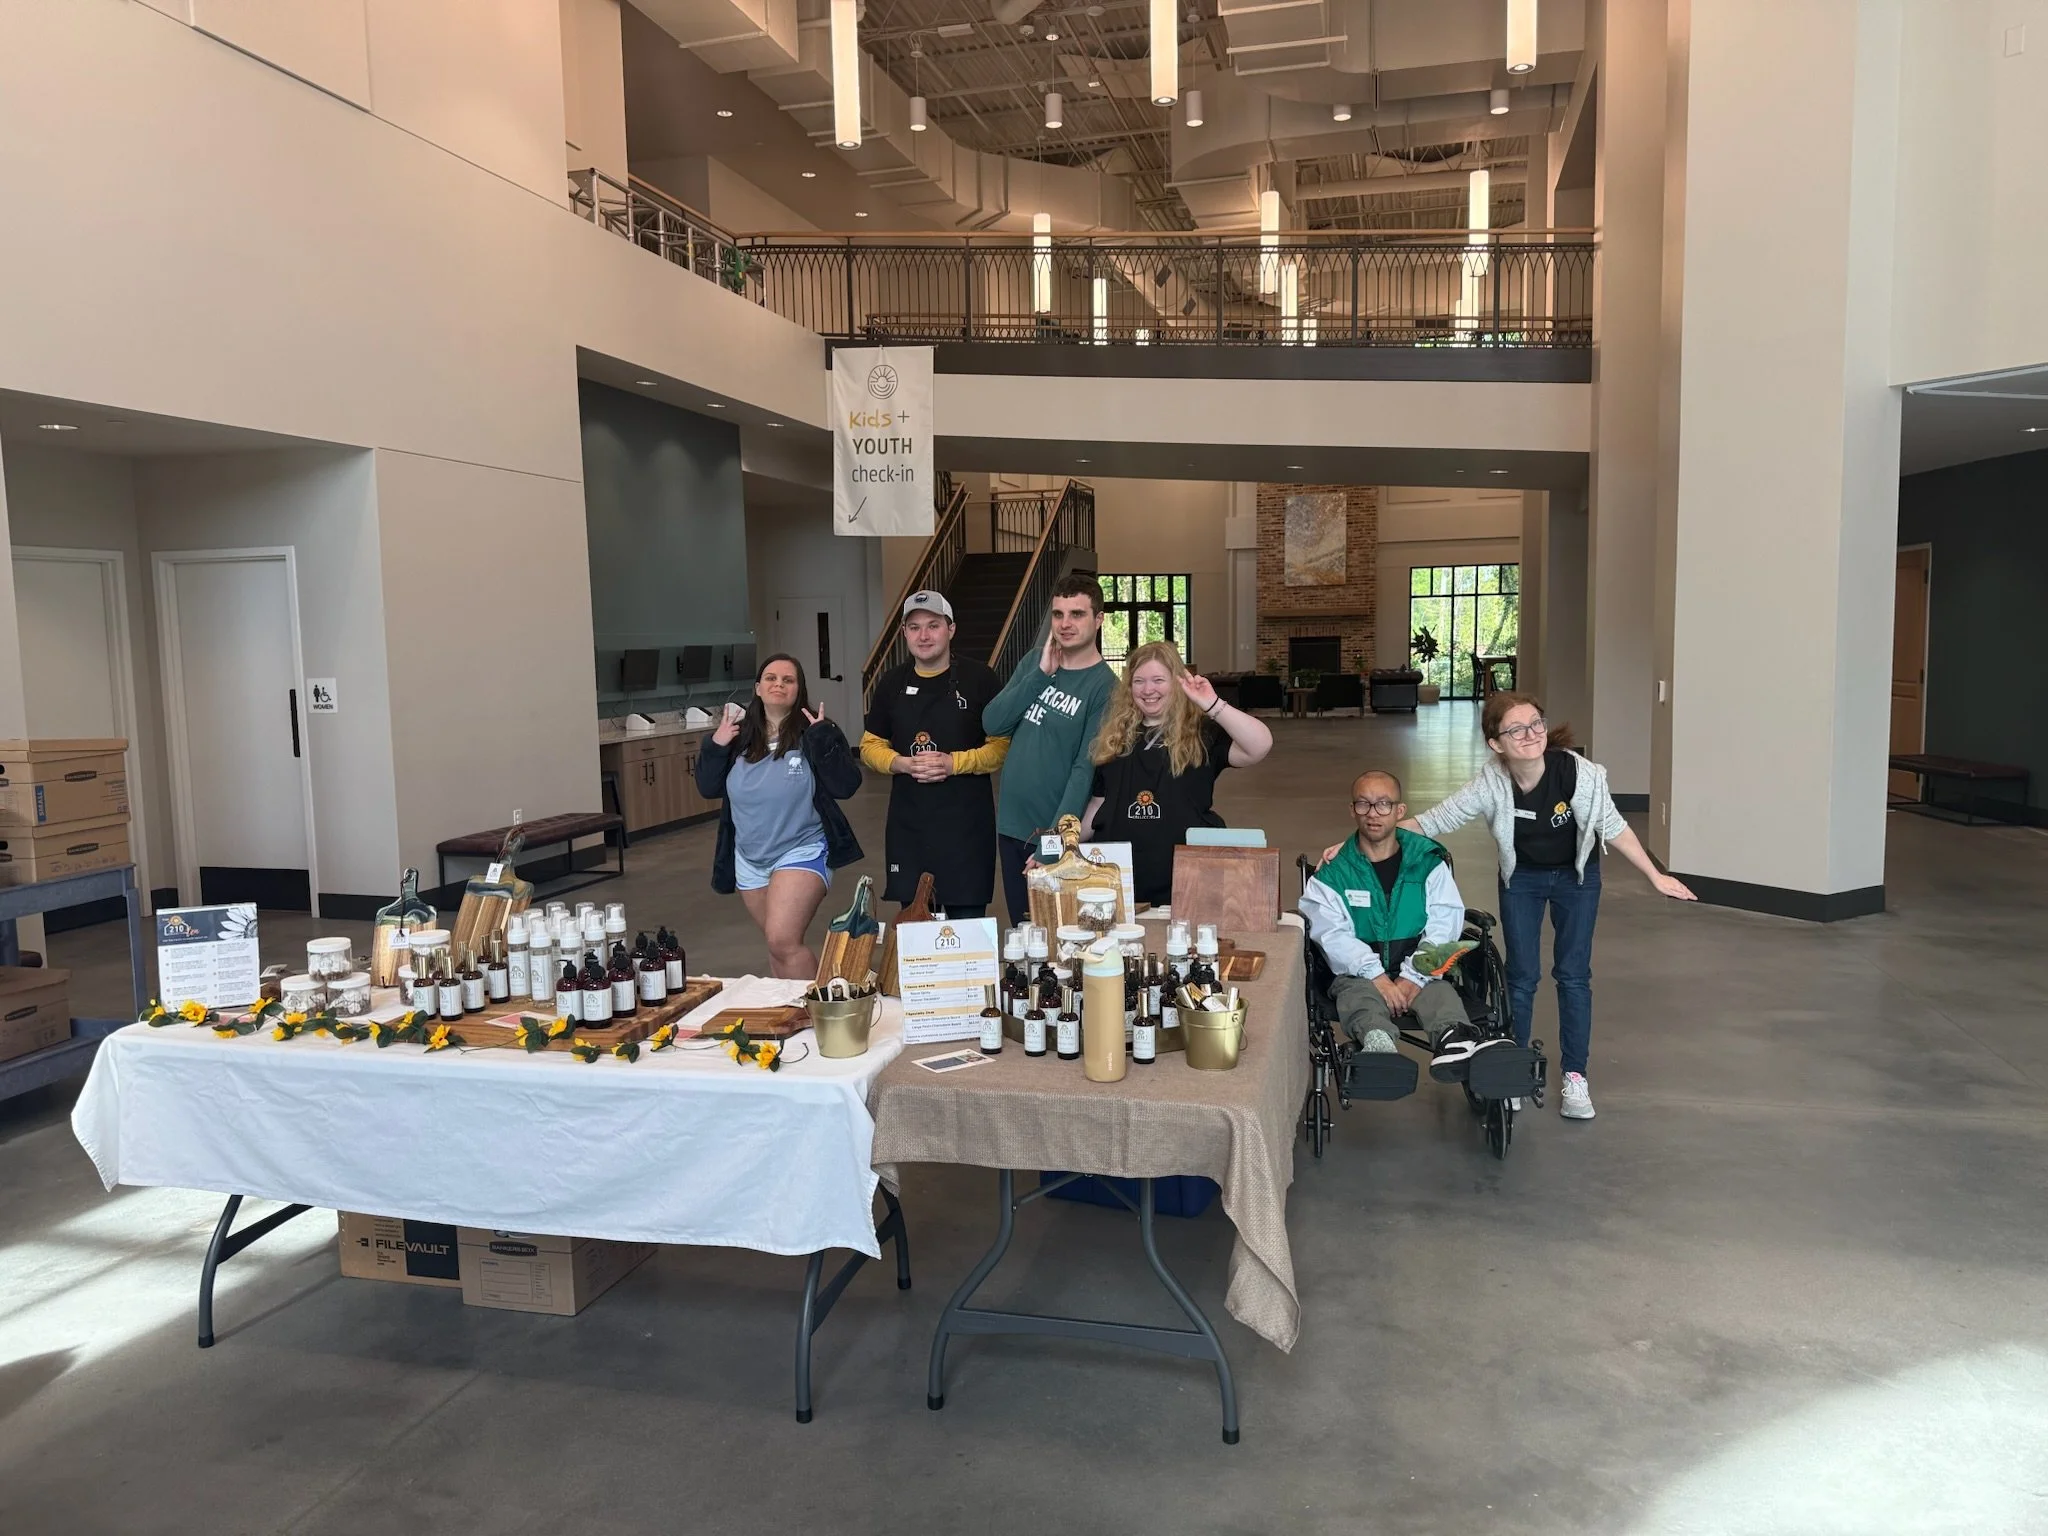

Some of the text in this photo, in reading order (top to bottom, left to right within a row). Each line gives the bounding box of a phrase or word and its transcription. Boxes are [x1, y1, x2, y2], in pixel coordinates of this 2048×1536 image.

[849, 409, 910, 429] Kids +
[852, 438, 912, 455] YOUTH
[852, 464, 914, 483] check-in
[1135, 805, 1154, 816] 210
[170, 925, 185, 933] 210
[941, 938, 955, 946] 210
[376, 1239, 450, 1256] FILEVAULT
